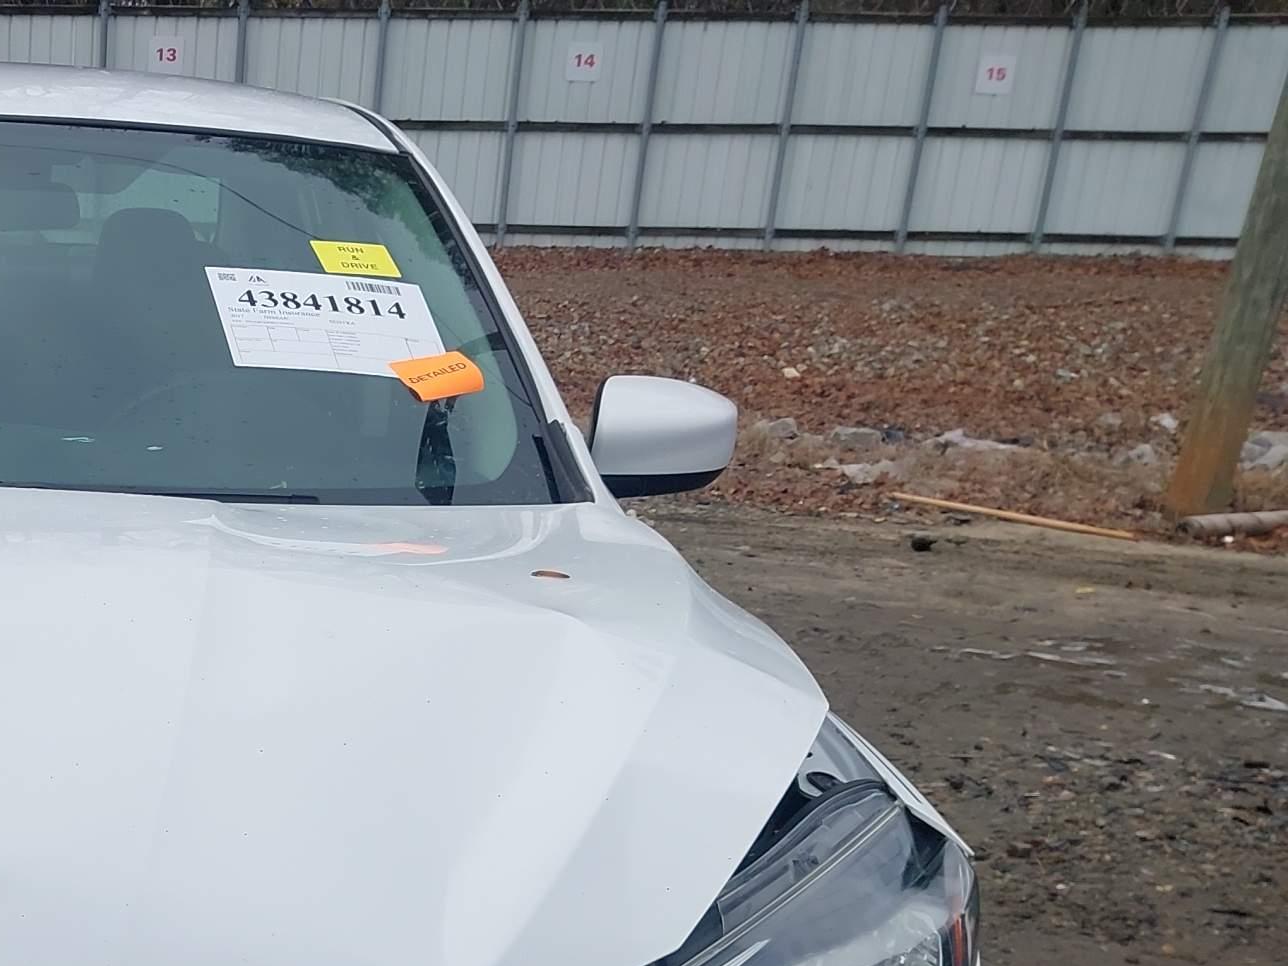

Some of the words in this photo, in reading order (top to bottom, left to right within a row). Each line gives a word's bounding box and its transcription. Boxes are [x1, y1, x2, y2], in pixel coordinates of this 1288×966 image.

[156, 47, 177, 62] 13
[575, 53, 597, 68] 14
[987, 66, 1008, 81] 15
[336, 246, 365, 254] RUN
[339, 261, 380, 271] DRIVE
[237, 289, 407, 320] 43841814
[408, 362, 467, 384] DETAILED
